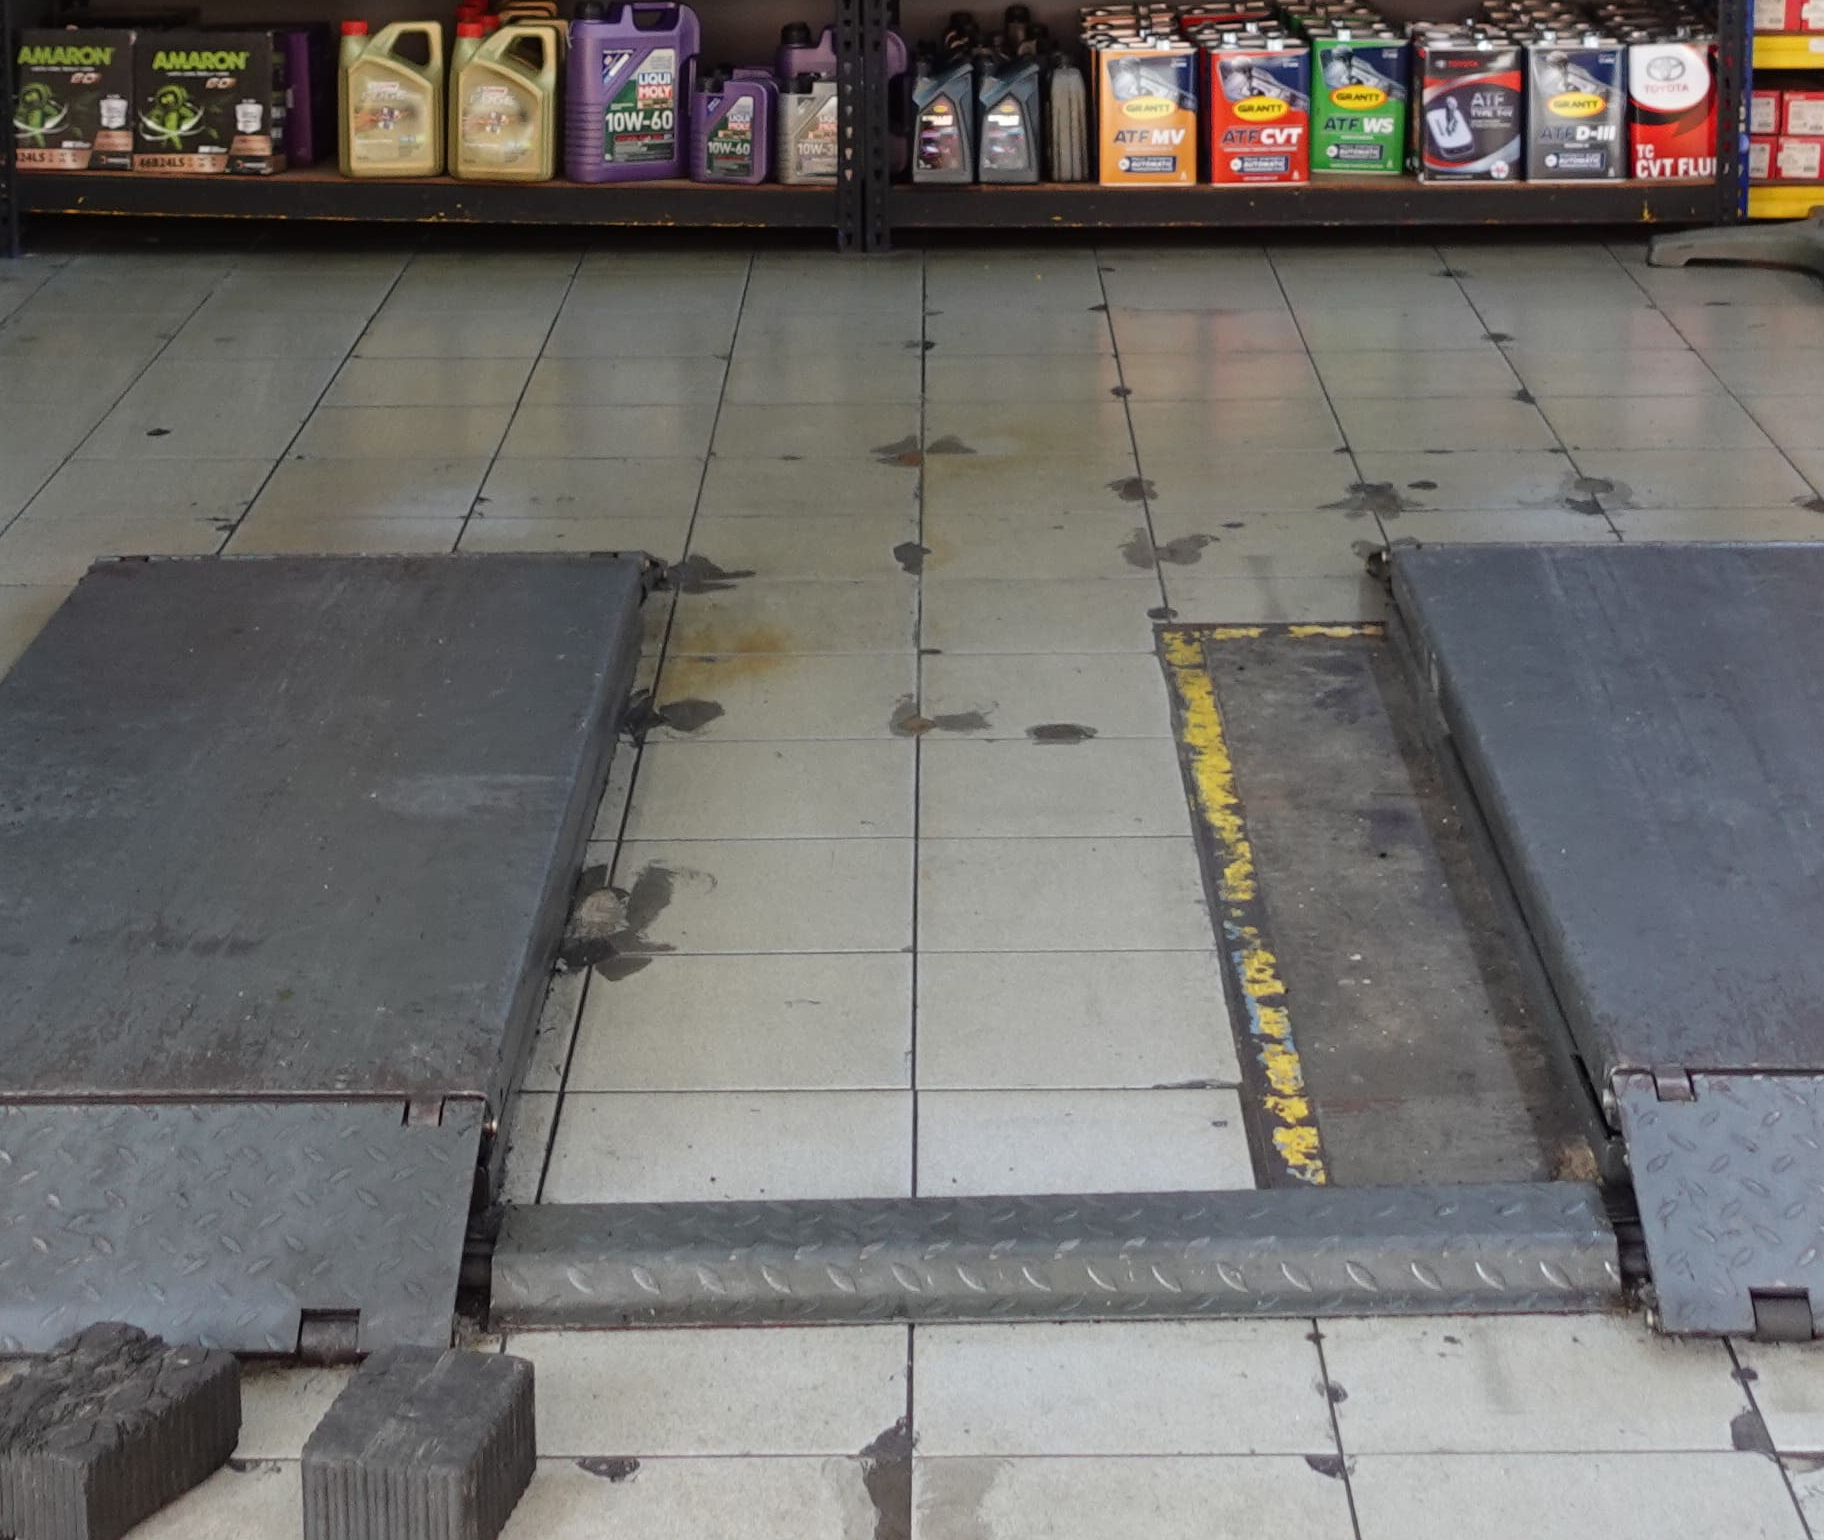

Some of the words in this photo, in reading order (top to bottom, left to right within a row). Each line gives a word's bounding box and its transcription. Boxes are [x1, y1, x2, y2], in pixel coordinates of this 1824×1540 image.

[18, 45, 110, 66] AMARON
[153, 50, 246, 71] AMARON
[638, 72, 671, 85] LIQUI
[638, 85, 672, 99] MOLY
[1336, 93, 1381, 102] GRANTT
[1470, 92, 1505, 107] ATF
[1237, 104, 1283, 113] GRANTT
[605, 111, 674, 132] 10W-60
[1324, 117, 1359, 131] ATF
[1362, 117, 1394, 133] WS
[1113, 129, 1148, 144] ATF
[1151, 128, 1185, 145] MV
[1223, 129, 1259, 144] ATF
[1260, 127, 1303, 145] CVT
[1576, 125, 1616, 141] D-III
[707, 141, 751, 155] 10W-60
[797, 142, 837, 155] 10W-3
[1636, 144, 1655, 158] TC
[1636, 159, 1674, 178] CVT
[1678, 157, 1717, 177] FLUI
